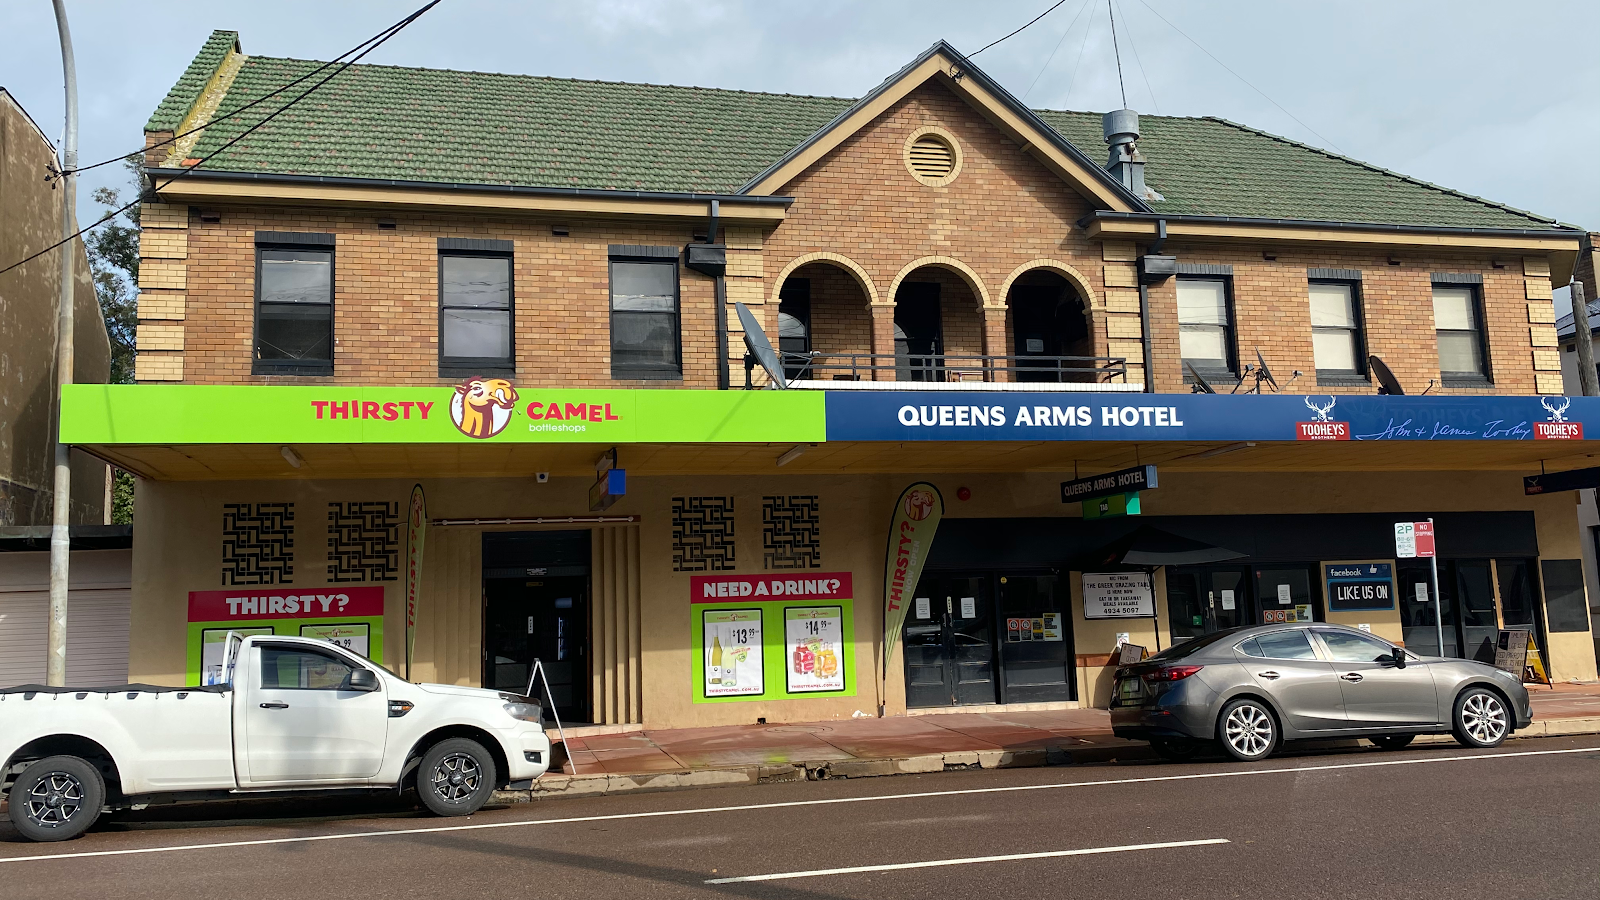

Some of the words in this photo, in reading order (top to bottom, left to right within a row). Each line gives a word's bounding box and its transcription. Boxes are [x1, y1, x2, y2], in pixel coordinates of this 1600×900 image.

[311, 400, 434, 421] THIRSTY
[526, 401, 619, 422] CAMEL
[898, 405, 1006, 427] QUEENS
[1014, 406, 1093, 427] ARMS
[1101, 406, 1184, 427] HOTEL
[529, 423, 586, 433] bottleshops
[1301, 424, 1345, 436] TOOHEYS
[1538, 424, 1579, 436] TOOHEYS
[1064, 482, 1092, 496] QUEENS
[1093, 477, 1115, 491] ARMS
[1118, 471, 1144, 486] HOTEL
[1397, 525, 1413, 534] 2P
[888, 520, 915, 612] THIRSTY?
[905, 570, 915, 593] NOW
[910, 540, 920, 567] OPEN
[1330, 567, 1361, 577] facebook
[407, 529, 417, 628] THIRSTY?
[703, 581, 752, 598] NEED
[754, 580, 770, 596] A
[771, 578, 840, 595] DRINK?
[1337, 586, 1360, 600] LIKE
[1361, 585, 1374, 600] US
[1376, 585, 1388, 599] ON
[226, 594, 349, 615] THIRSTY?
